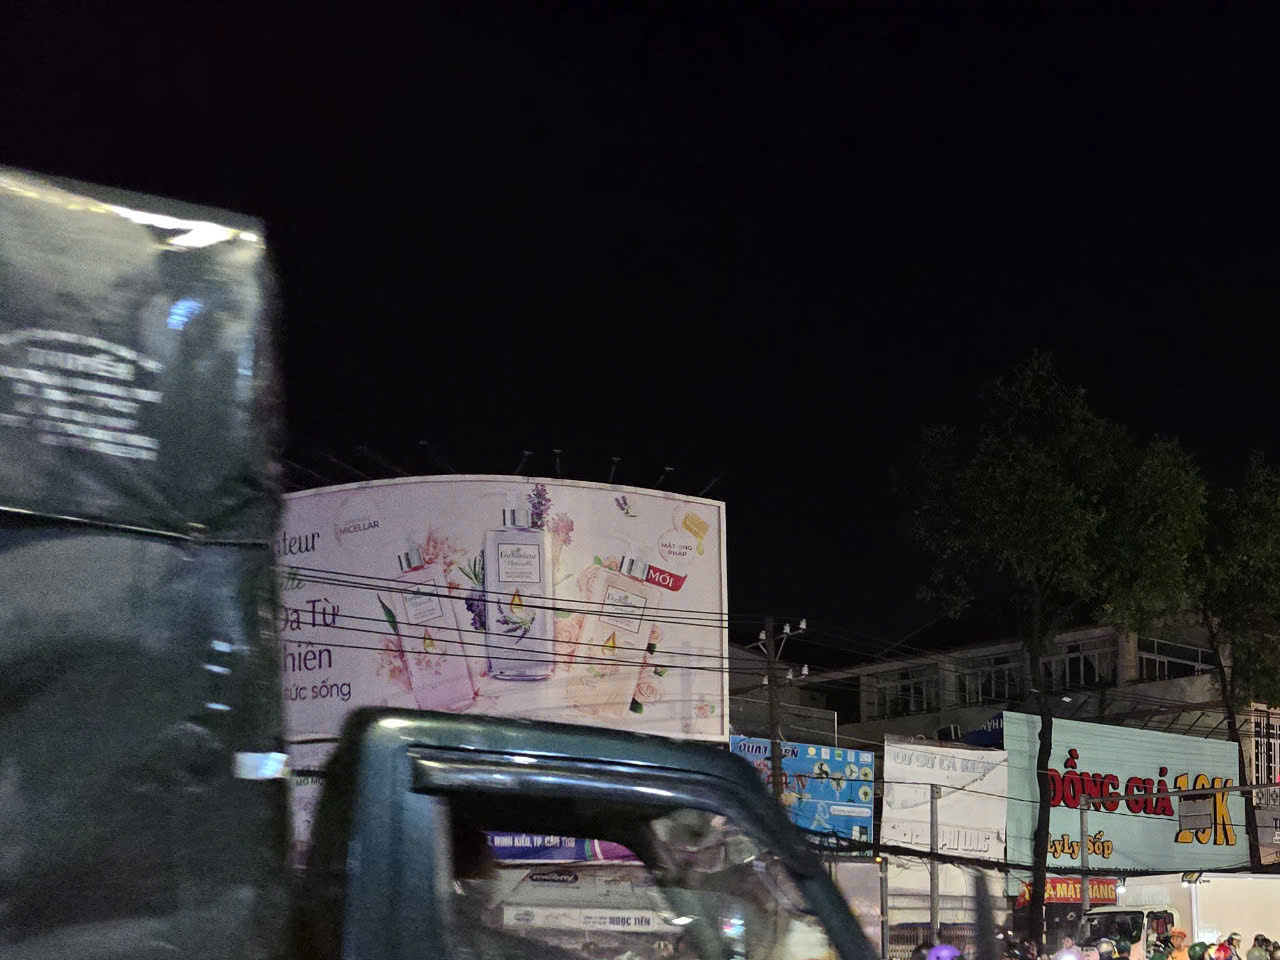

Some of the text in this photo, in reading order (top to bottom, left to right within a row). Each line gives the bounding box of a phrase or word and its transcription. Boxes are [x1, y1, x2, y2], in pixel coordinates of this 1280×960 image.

[339, 521, 380, 535] MICELLAR
[647, 568, 673, 587] MỚI
[306, 597, 339, 628] Từ
[311, 677, 351, 701] sống
[1124, 766, 1174, 816] GIÁ
[1048, 830, 1113, 860] LyLy Sốp
